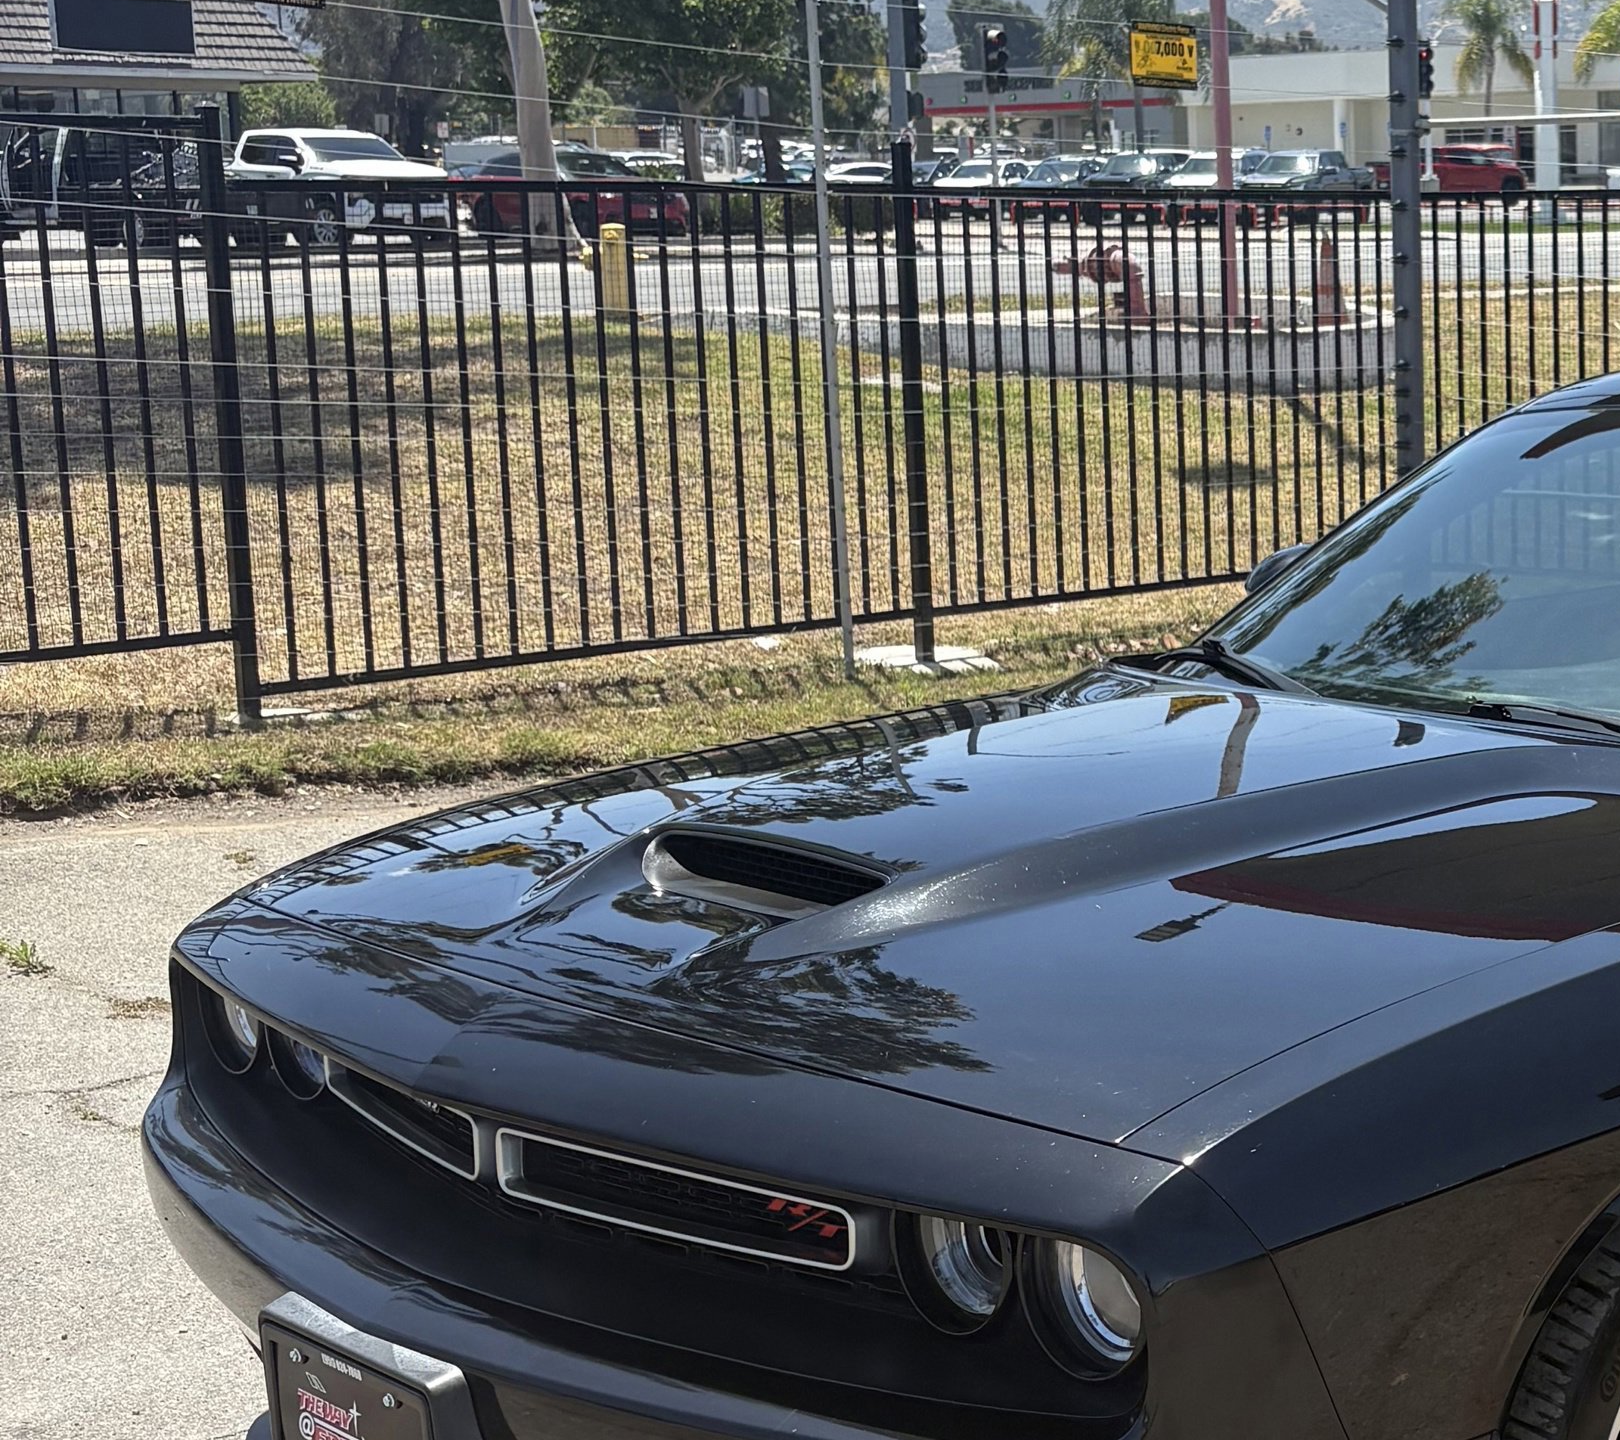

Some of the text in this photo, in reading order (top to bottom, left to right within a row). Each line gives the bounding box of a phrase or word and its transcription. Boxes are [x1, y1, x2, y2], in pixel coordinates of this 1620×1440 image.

[1155, 41, 1194, 58] 7,000 V
[766, 1198, 848, 1238] R/T
